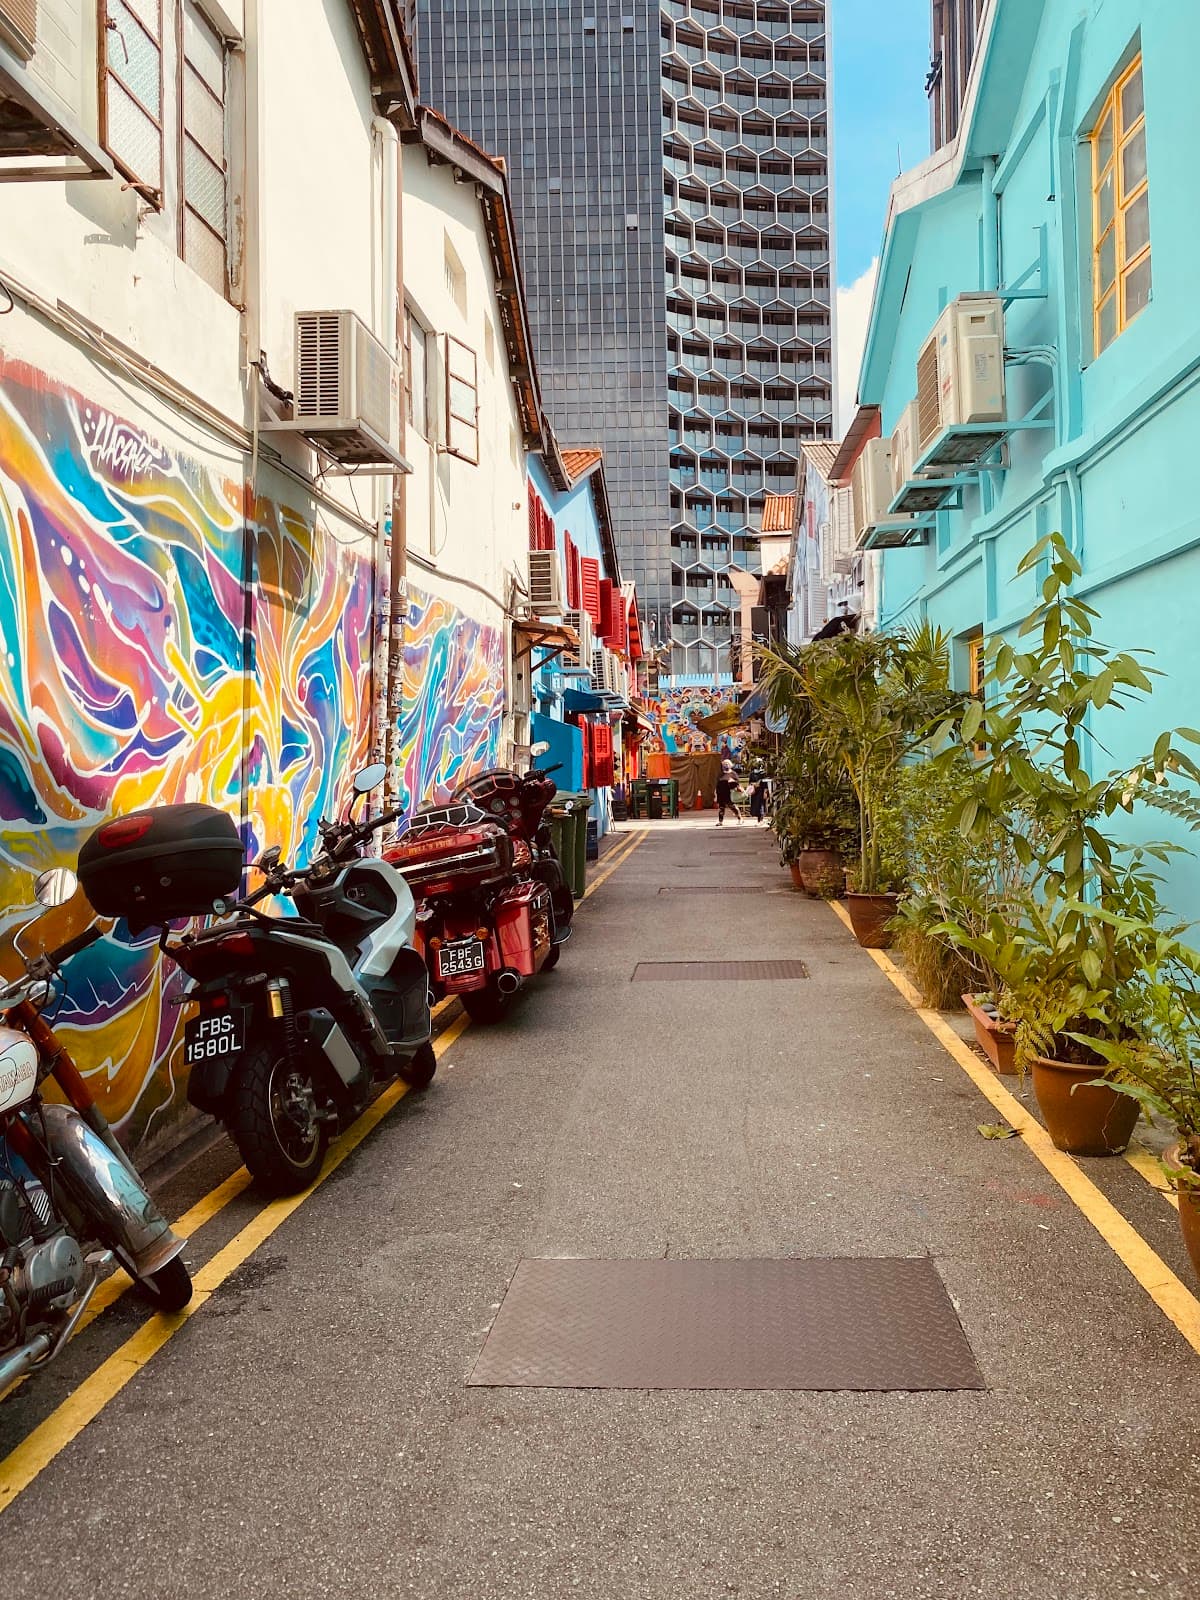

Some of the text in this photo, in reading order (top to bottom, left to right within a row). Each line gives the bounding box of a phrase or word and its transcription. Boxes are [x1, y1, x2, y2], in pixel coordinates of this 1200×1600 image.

[448, 946, 473, 961] FBF
[200, 1015, 232, 1038] FBS
[187, 1033, 242, 1062] 1580L
